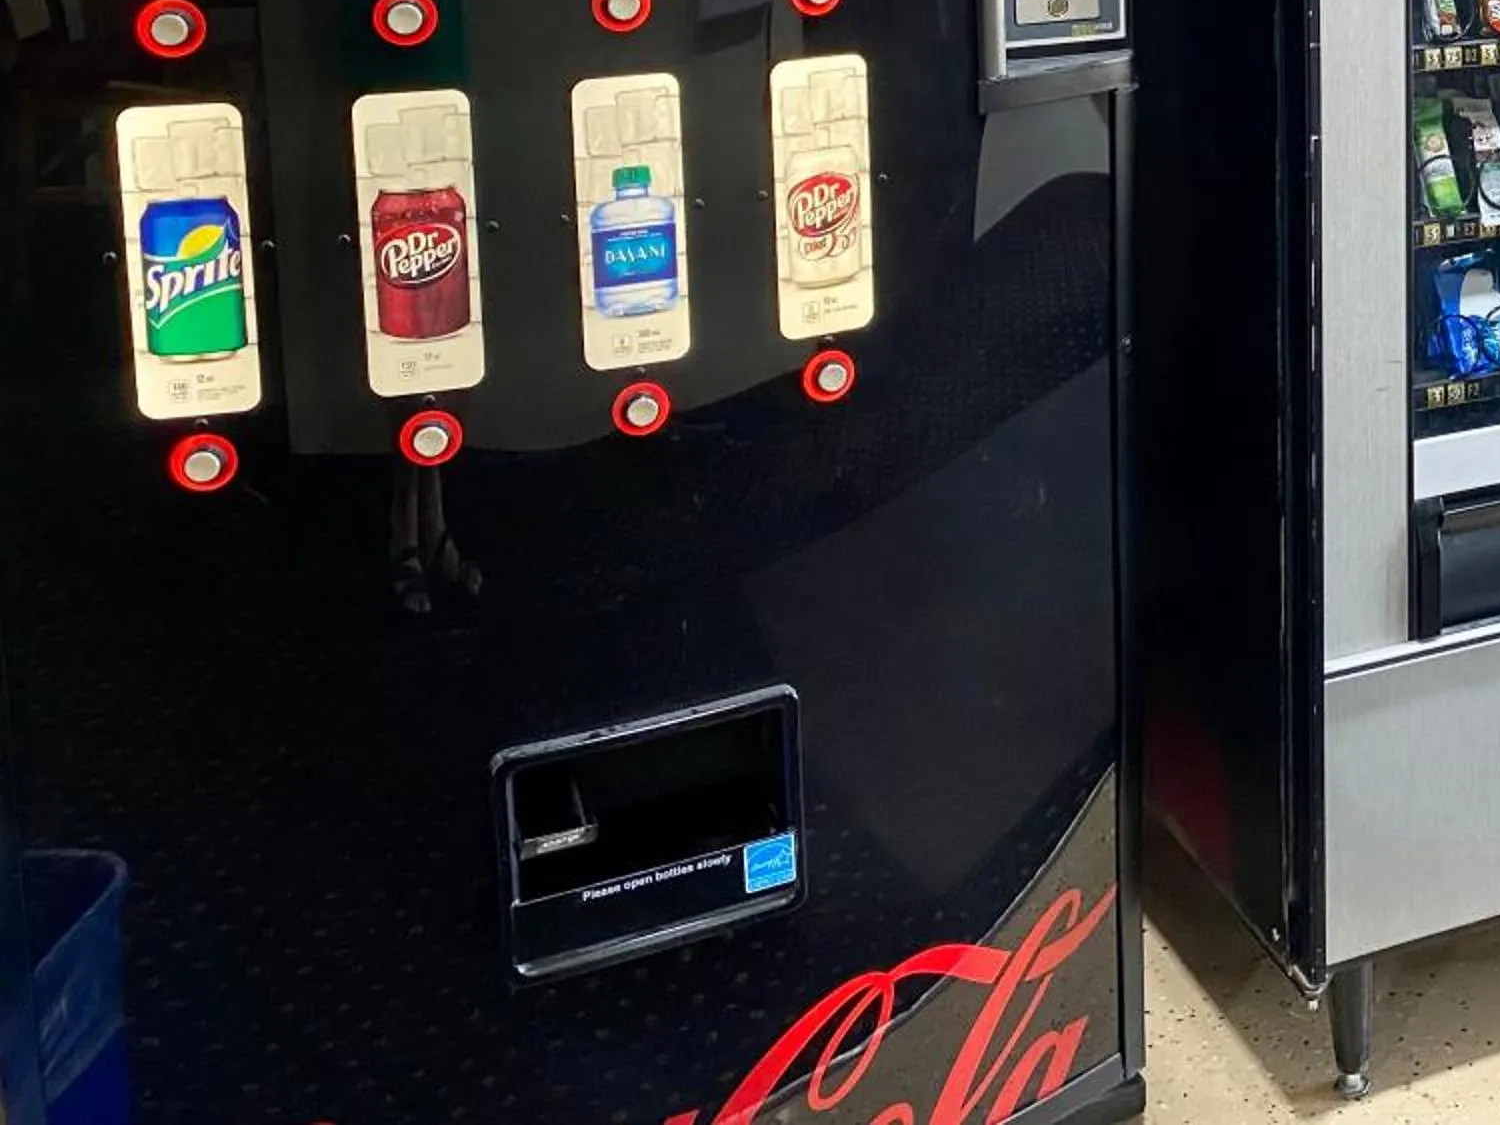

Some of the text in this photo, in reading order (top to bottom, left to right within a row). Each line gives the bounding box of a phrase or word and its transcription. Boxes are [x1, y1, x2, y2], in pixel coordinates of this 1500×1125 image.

[793, 188, 854, 230] Pepper
[812, 182, 840, 208] Dr
[386, 236, 457, 280] Pepper
[407, 231, 440, 256] Dr
[145, 241, 242, 314] Sprite
[582, 853, 733, 902] Please open bottles slowly
